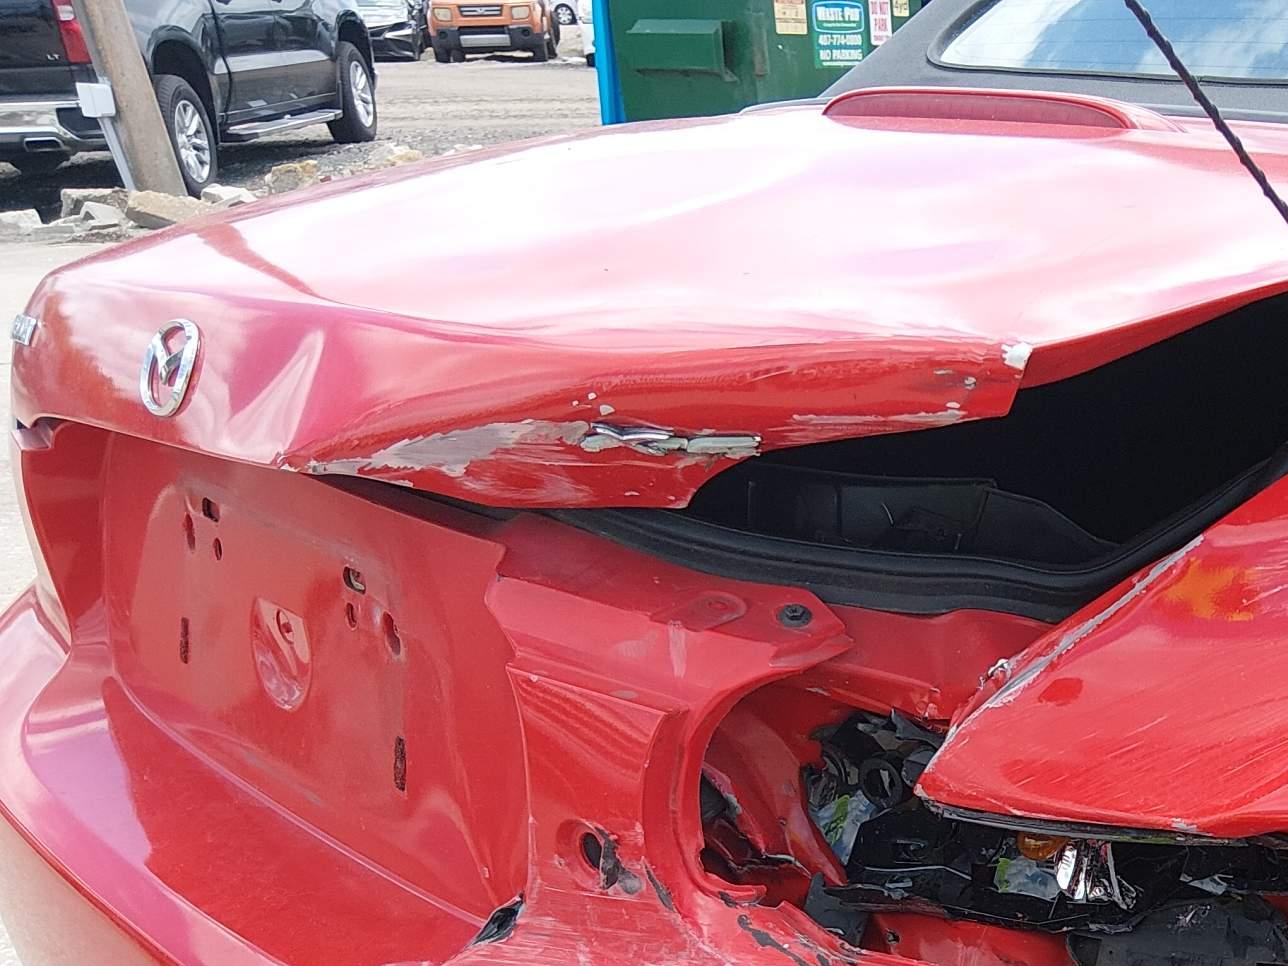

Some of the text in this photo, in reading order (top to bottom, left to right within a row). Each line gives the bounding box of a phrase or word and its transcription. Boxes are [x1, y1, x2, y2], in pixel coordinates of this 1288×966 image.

[46, 53, 60, 61] LT
[819, 49, 863, 60] NO PARKING
